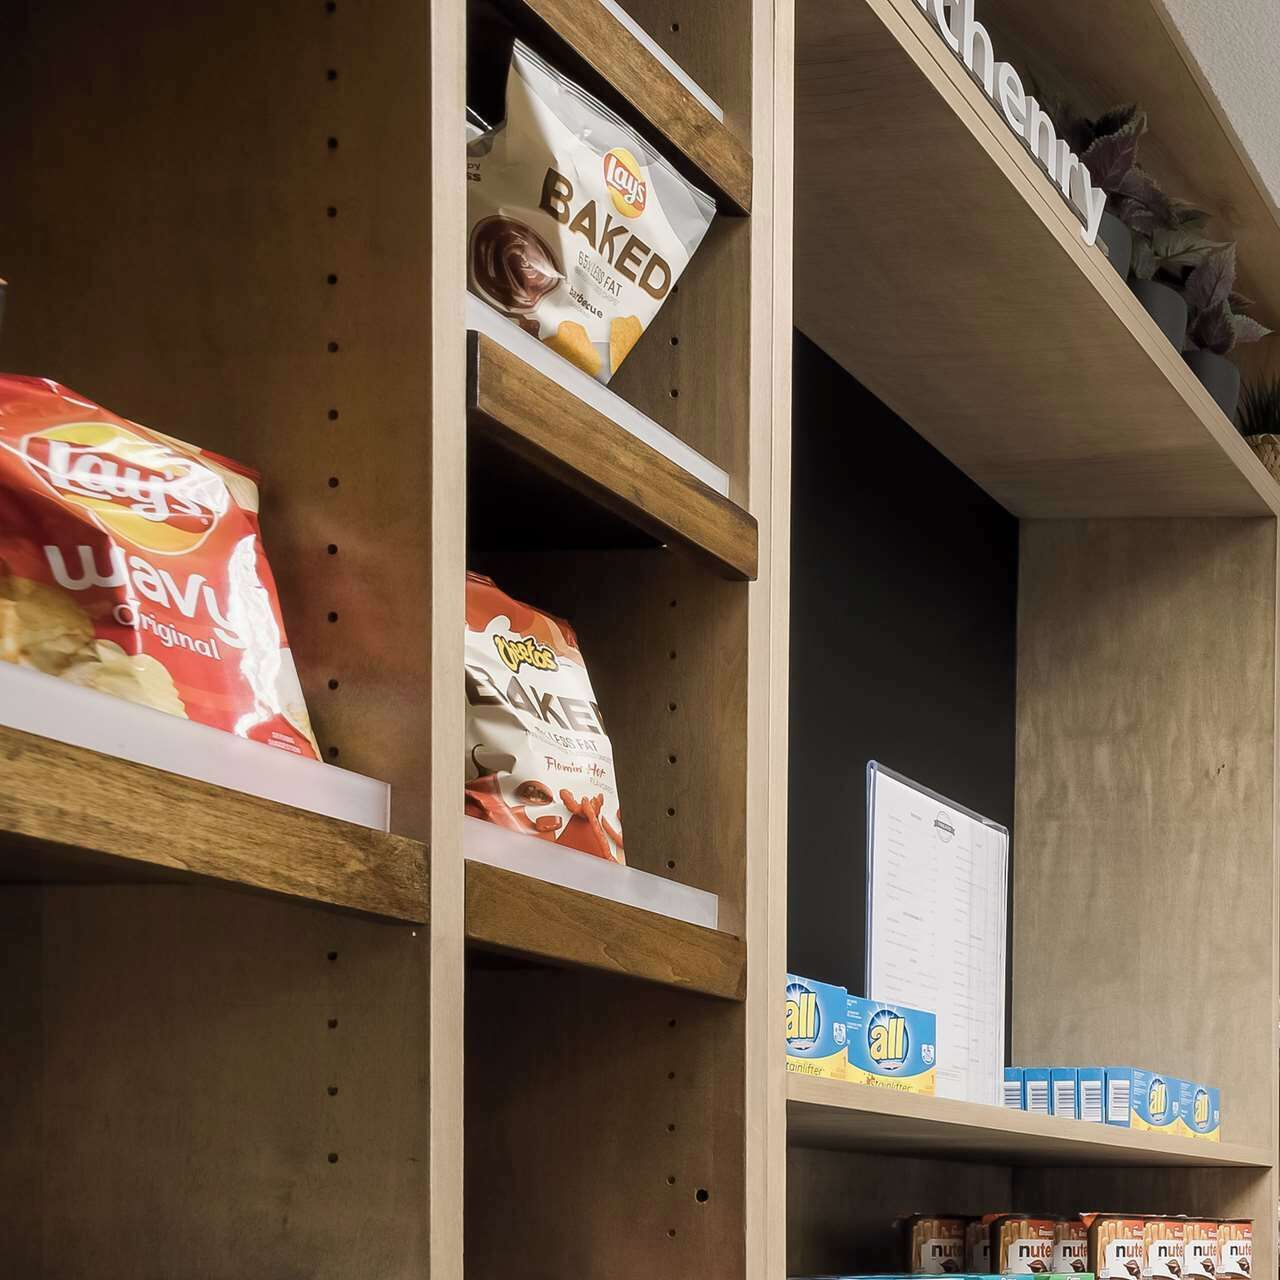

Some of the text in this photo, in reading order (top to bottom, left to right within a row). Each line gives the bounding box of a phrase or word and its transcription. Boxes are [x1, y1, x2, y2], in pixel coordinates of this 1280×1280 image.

[540, 167, 672, 301] BAKED
[568, 286, 604, 319] barbecue
[603, 275, 623, 298] FAT
[113, 599, 222, 661] Original
[493, 634, 559, 673] Cheetos
[786, 992, 816, 1040] all
[869, 1016, 906, 1061] all
[786, 1061, 824, 1076] tainlifter
